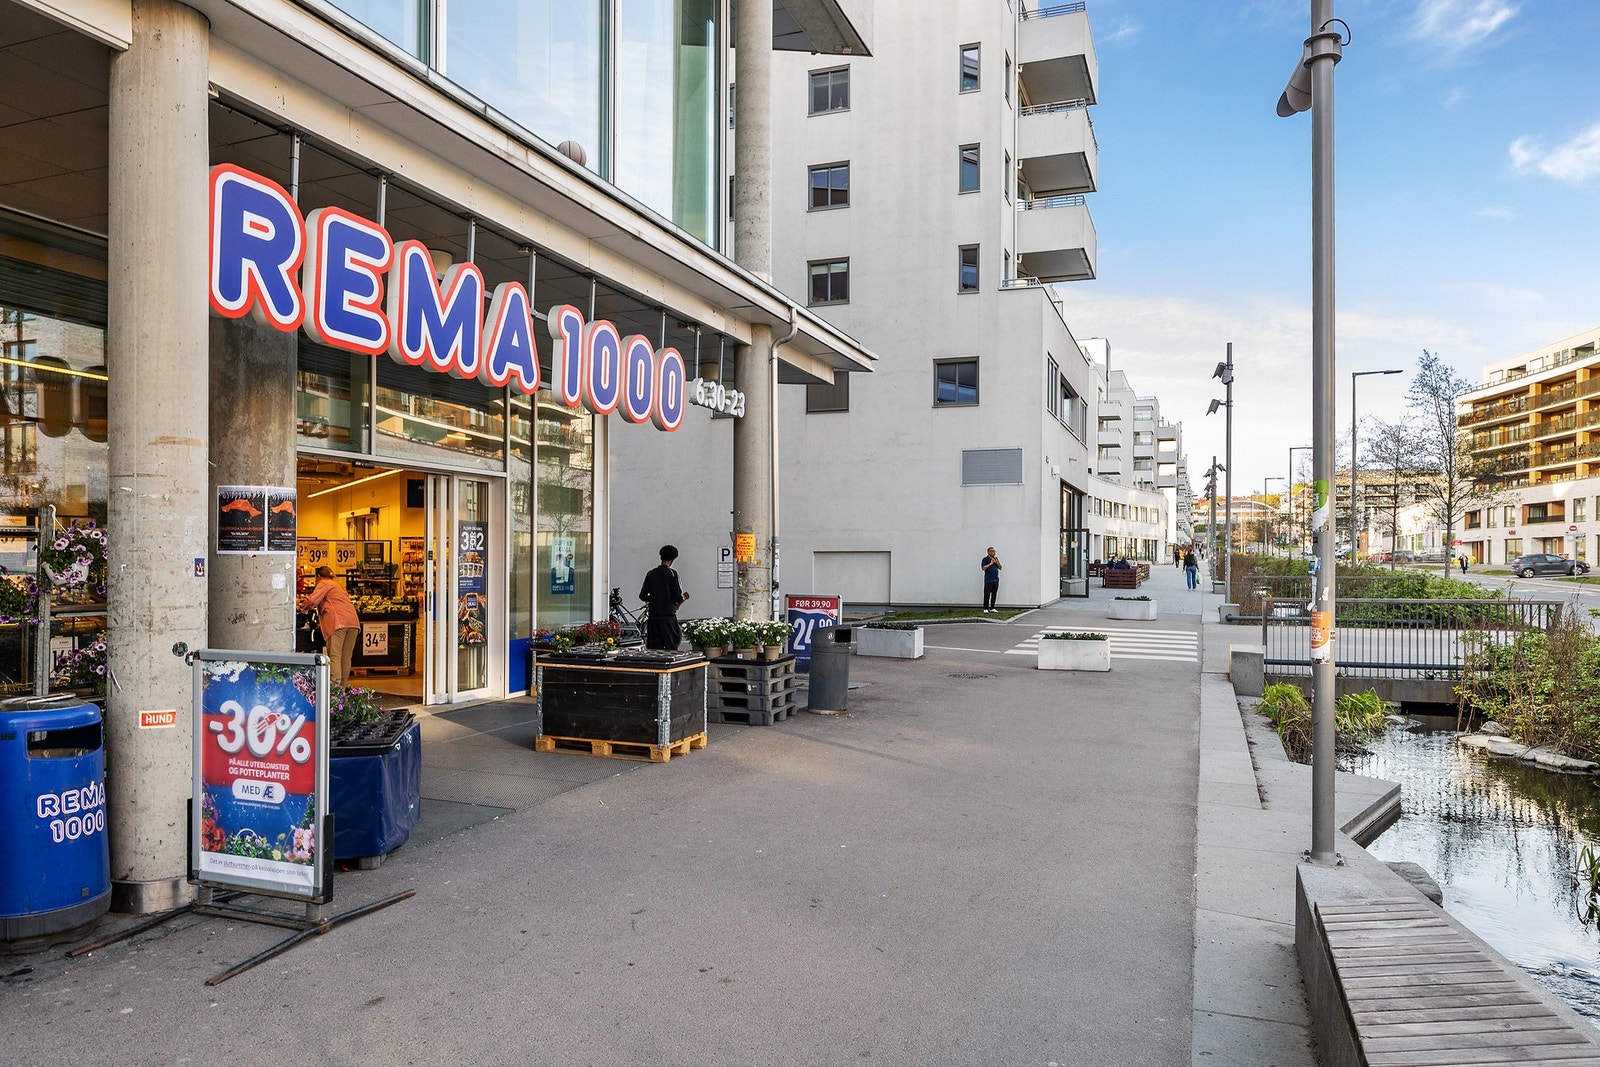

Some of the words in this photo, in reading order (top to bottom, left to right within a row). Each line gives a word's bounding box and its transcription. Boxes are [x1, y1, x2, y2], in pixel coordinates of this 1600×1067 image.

[209, 162, 541, 395] REMA
[548, 304, 686, 432] 1000
[461, 531, 469, 551] 3
[476, 531, 484, 551] 2
[721, 548, 731, 562] P
[795, 600, 810, 608] FØR
[811, 600, 831, 609] 39,90
[145, 714, 173, 724] HUND
[209, 700, 312, 764] -30%
[228, 757, 237, 765] PÅ
[237, 759, 249, 767] ALLE
[250, 759, 290, 772] UTEBLOMSTER
[228, 767, 239, 775] OG
[239, 767, 290, 781] POTTEPLANTER
[241, 784, 261, 796] MED
[263, 785, 274, 799] Æ
[37, 783, 105, 818] REMA
[50, 809, 104, 842] 1000
[209, 857, 218, 865] Det
